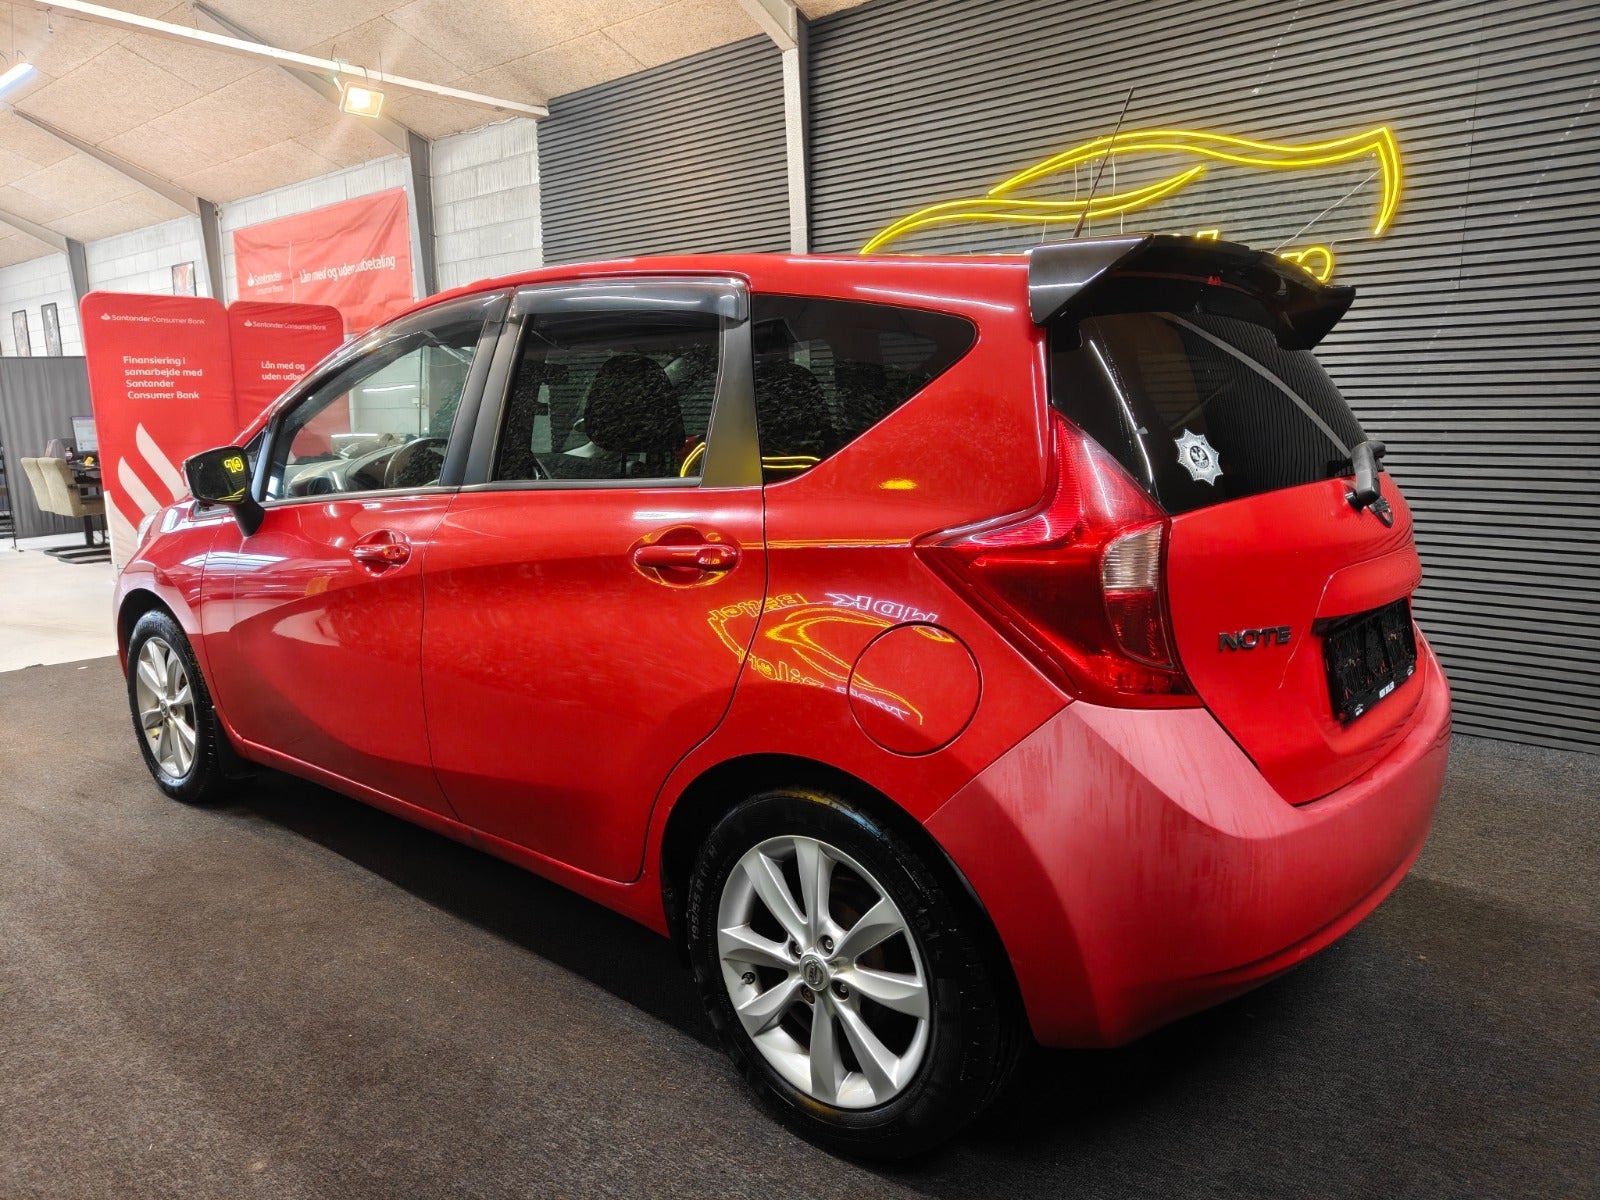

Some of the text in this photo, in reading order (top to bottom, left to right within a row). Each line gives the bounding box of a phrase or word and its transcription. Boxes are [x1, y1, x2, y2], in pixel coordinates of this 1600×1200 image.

[312, 266, 327, 281] med
[327, 267, 338, 282] og
[111, 314, 151, 322] Santander
[151, 316, 187, 324] Consumer
[252, 321, 283, 329] Santander
[123, 356, 181, 367] Finansiering
[261, 360, 305, 371] Lån med og
[124, 367, 203, 378] samarbejde med
[261, 372, 306, 381] uden udbe
[125, 379, 175, 388] Santander
[127, 390, 200, 400] Consumer Bank
[1219, 625, 1291, 652] NOTE
